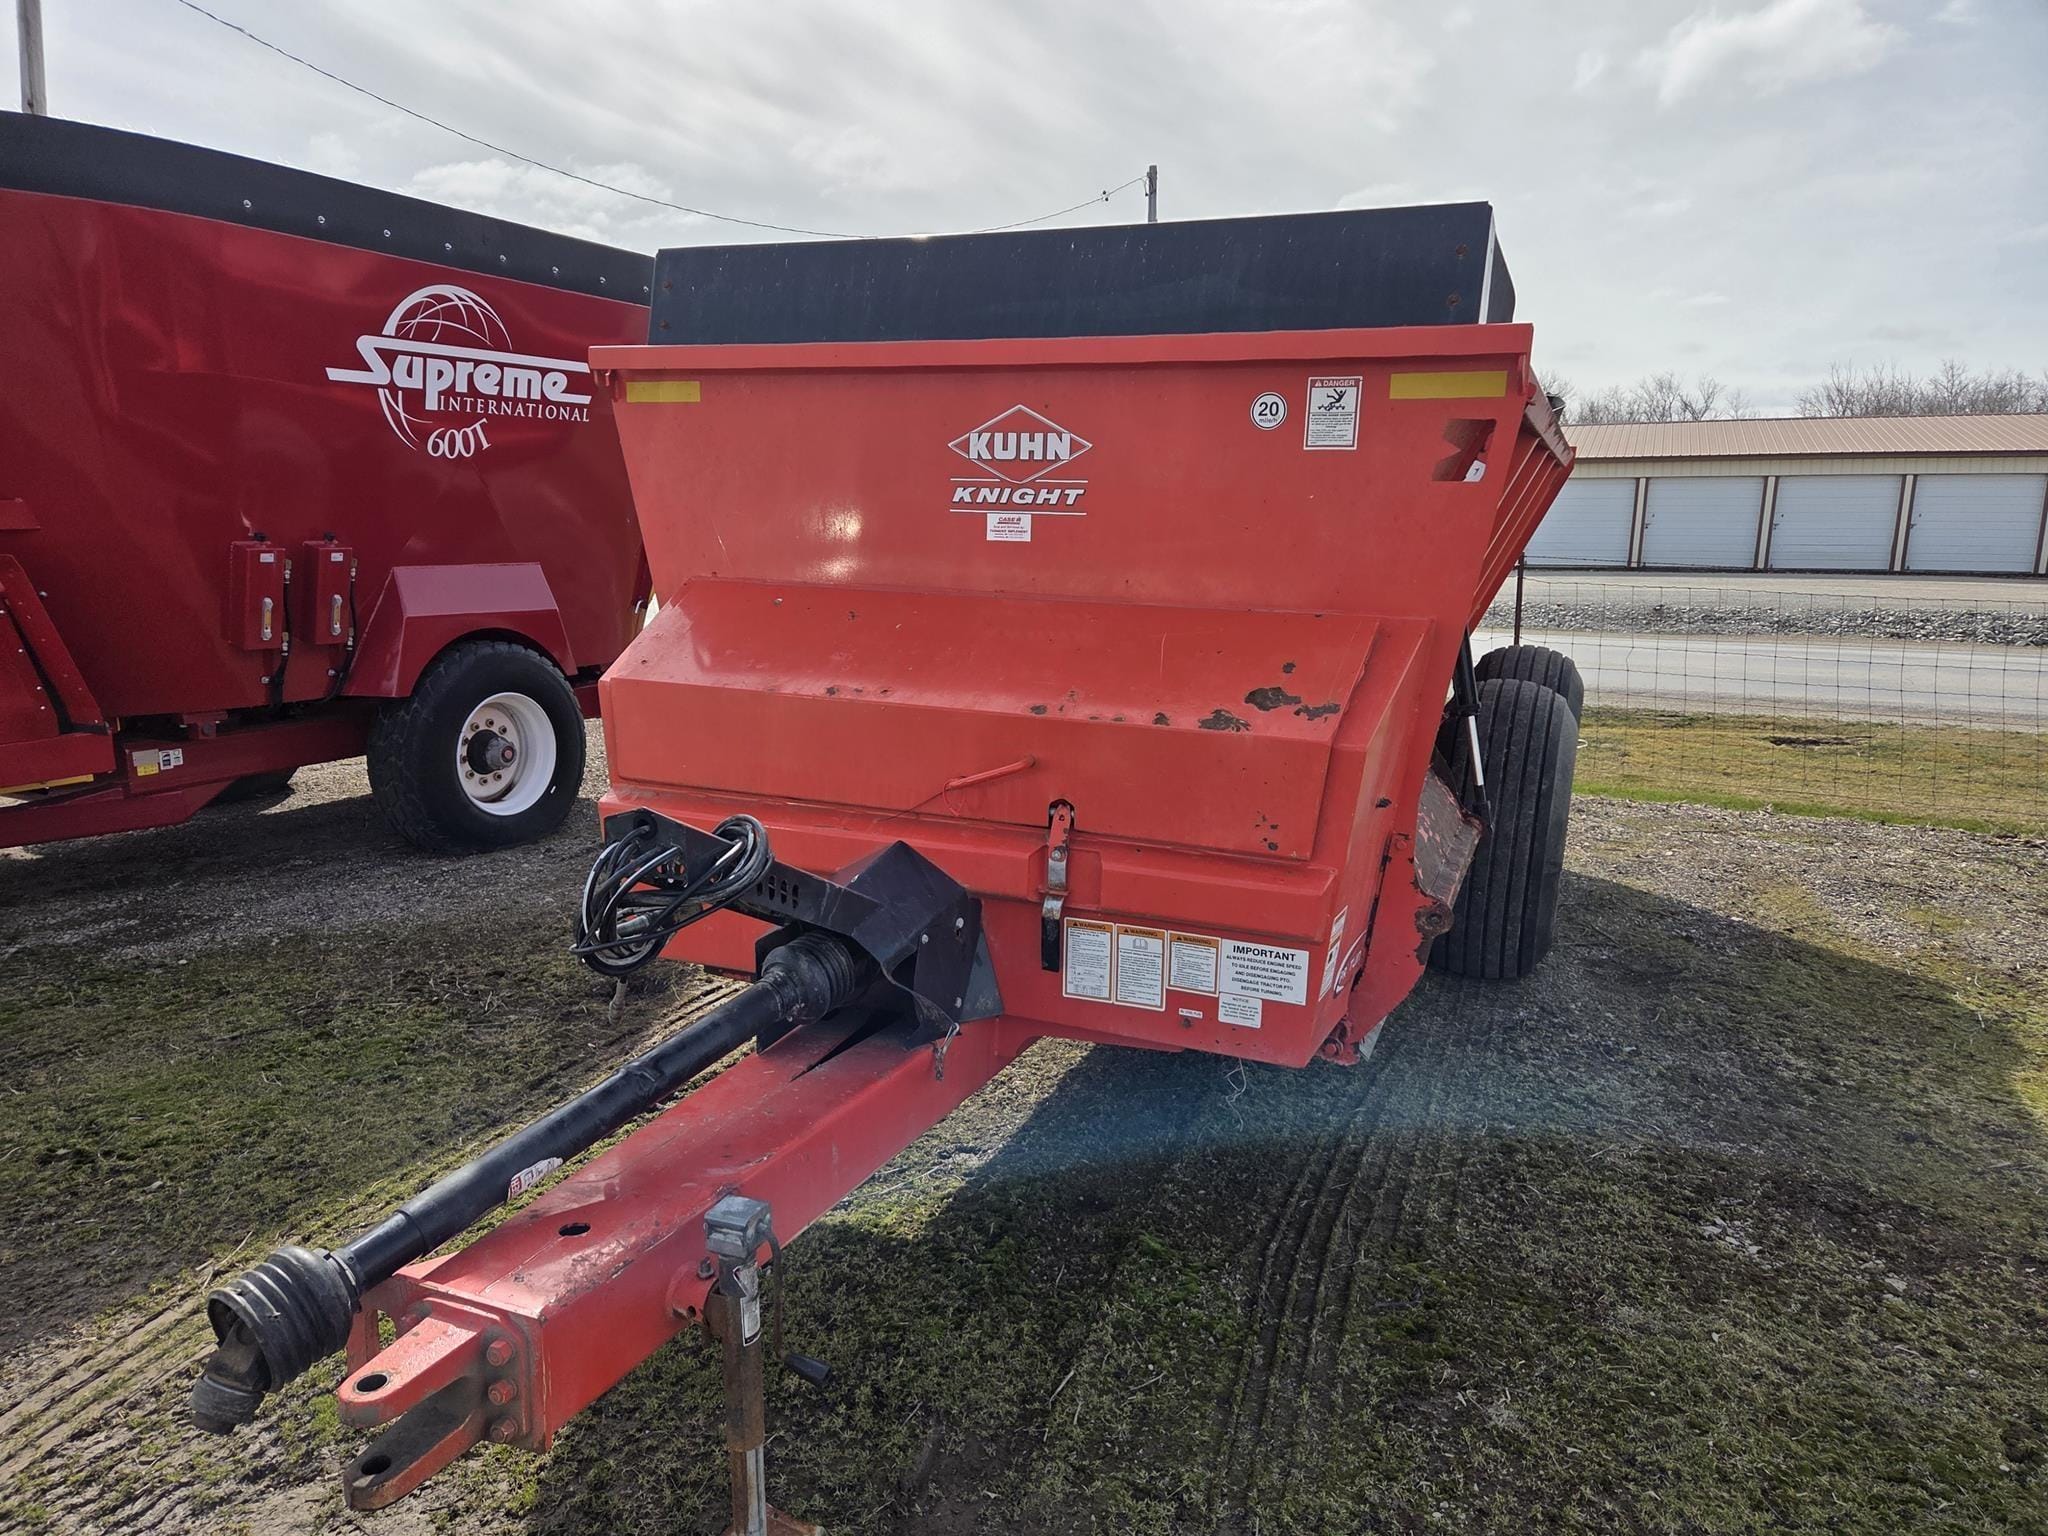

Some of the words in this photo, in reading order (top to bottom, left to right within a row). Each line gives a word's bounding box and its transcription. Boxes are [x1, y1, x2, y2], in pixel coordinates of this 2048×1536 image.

[325, 335, 592, 411] Supreme
[439, 395, 590, 423] INTERNATIONAL
[1258, 401, 1279, 417] 20
[426, 417, 493, 459] 600T
[968, 432, 1072, 461] KUHN
[952, 487, 1086, 506] KNIGHT
[1078, 922, 1106, 930] WARNING
[1131, 929, 1158, 937] WARNING
[1183, 936, 1212, 945] WARNING
[1233, 945, 1297, 962] IMPORTANT
[1247, 957, 1266, 965] REDUCE
[1267, 960, 1285, 968] ENGINE
[1286, 962, 1302, 970] SPEED
[1245, 972, 1279, 981] DISENGAGING
[1250, 965, 1269, 973] BEFORE
[1270, 967, 1296, 976] ENGAGING
[1232, 977, 1259, 986] DISENGAGE
[1260, 980, 1283, 989] TRACTOR
[1241, 985, 1260, 993] BEFORE
